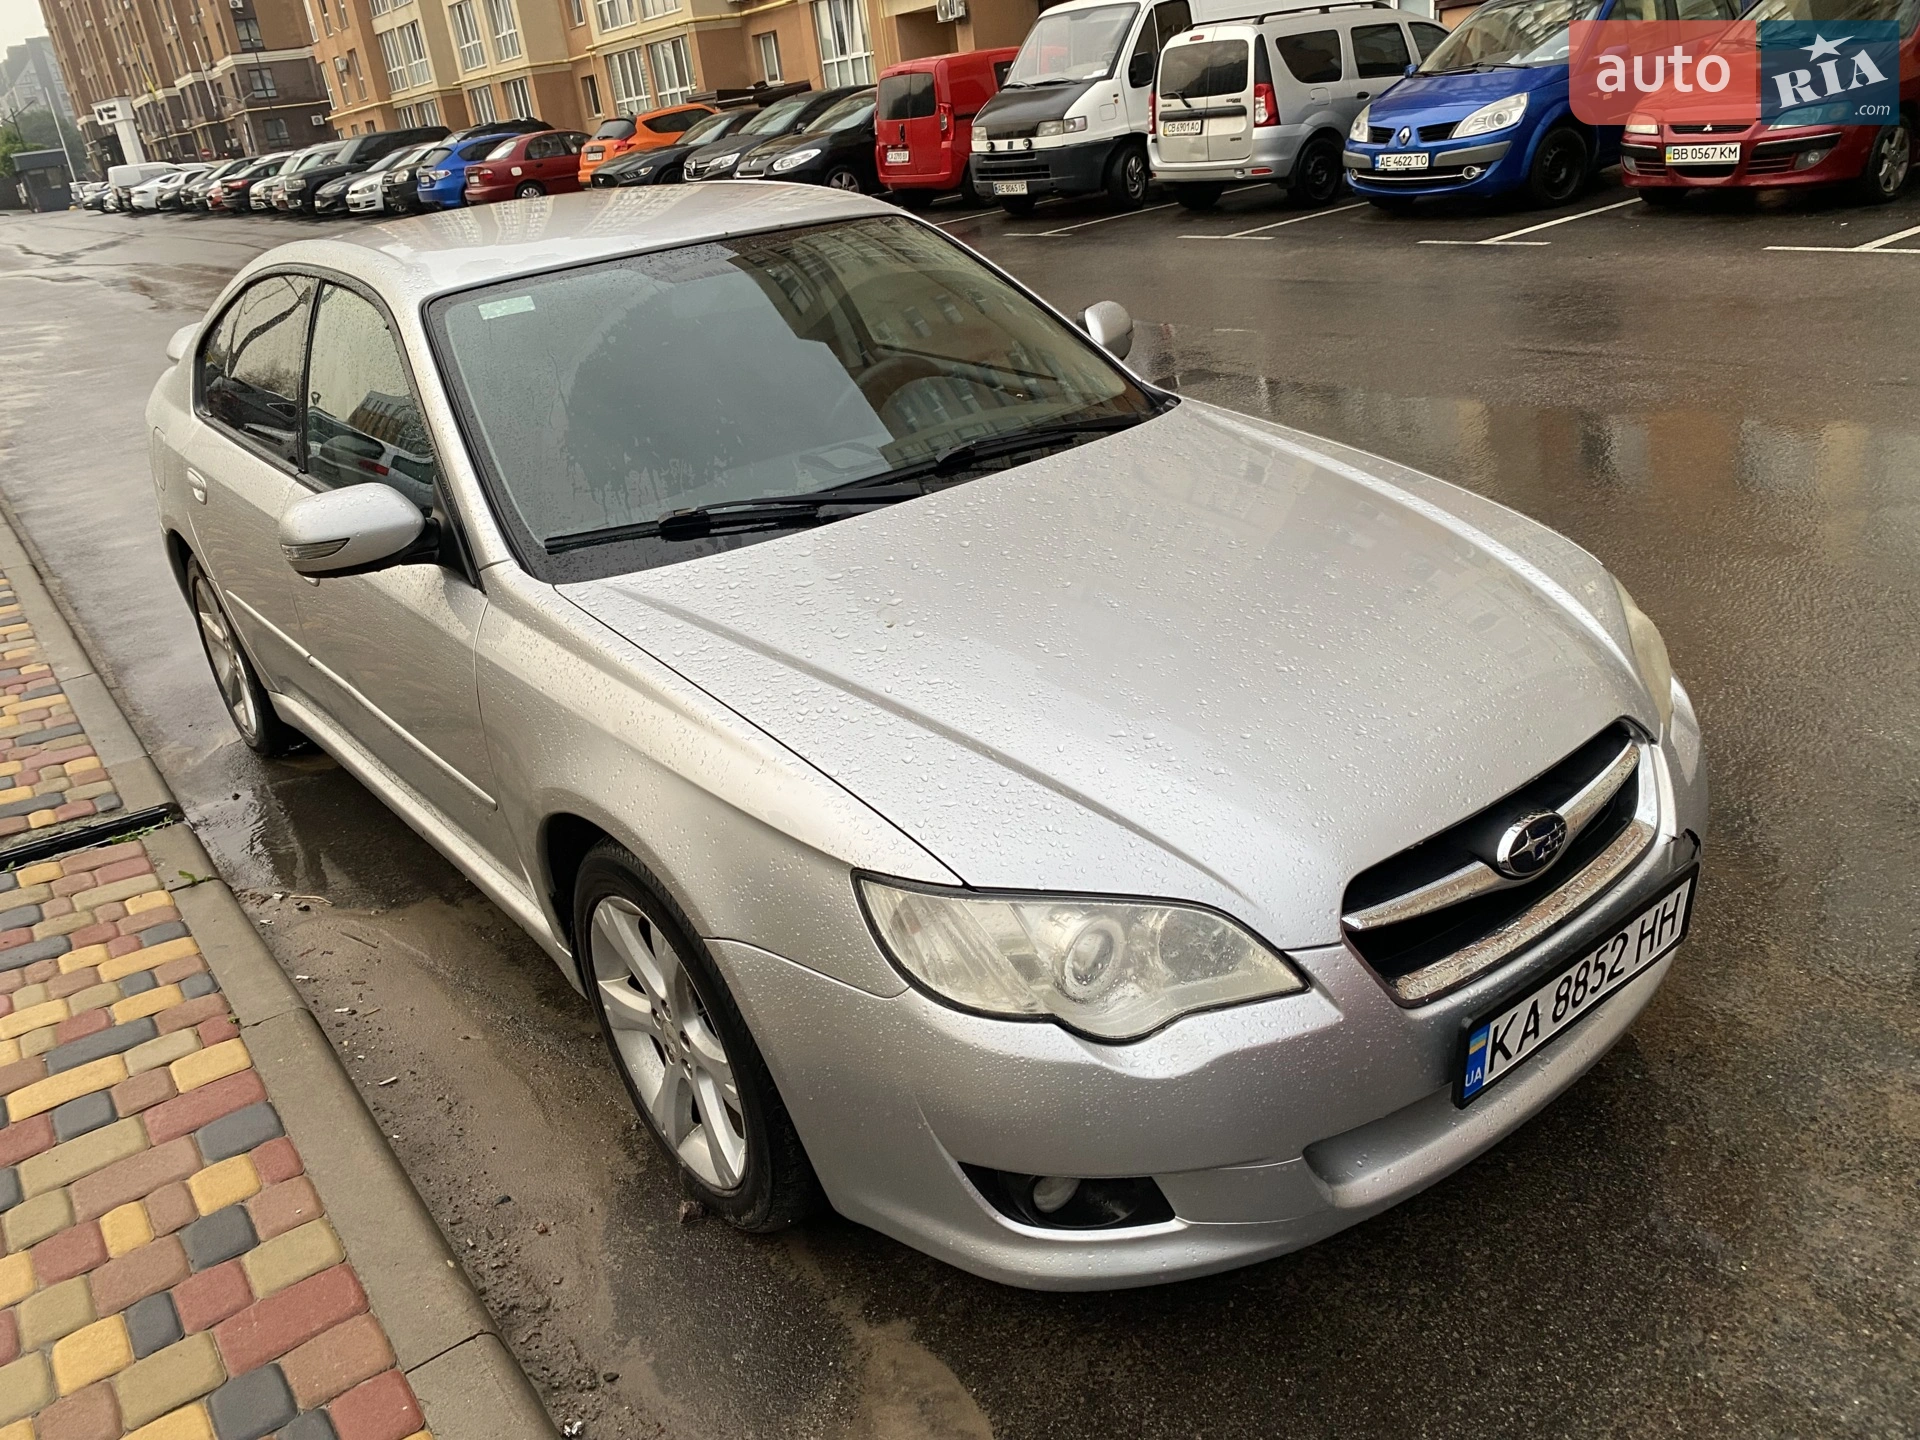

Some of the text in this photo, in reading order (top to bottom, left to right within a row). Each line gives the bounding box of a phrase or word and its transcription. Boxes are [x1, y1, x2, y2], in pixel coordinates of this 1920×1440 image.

[1380, 154, 1428, 167] AE 4622 TO
[1672, 146, 1738, 160] BB 0567 KM
[1487, 891, 1682, 1075] KA 8852 HH
[1465, 1067, 1482, 1088] UA
